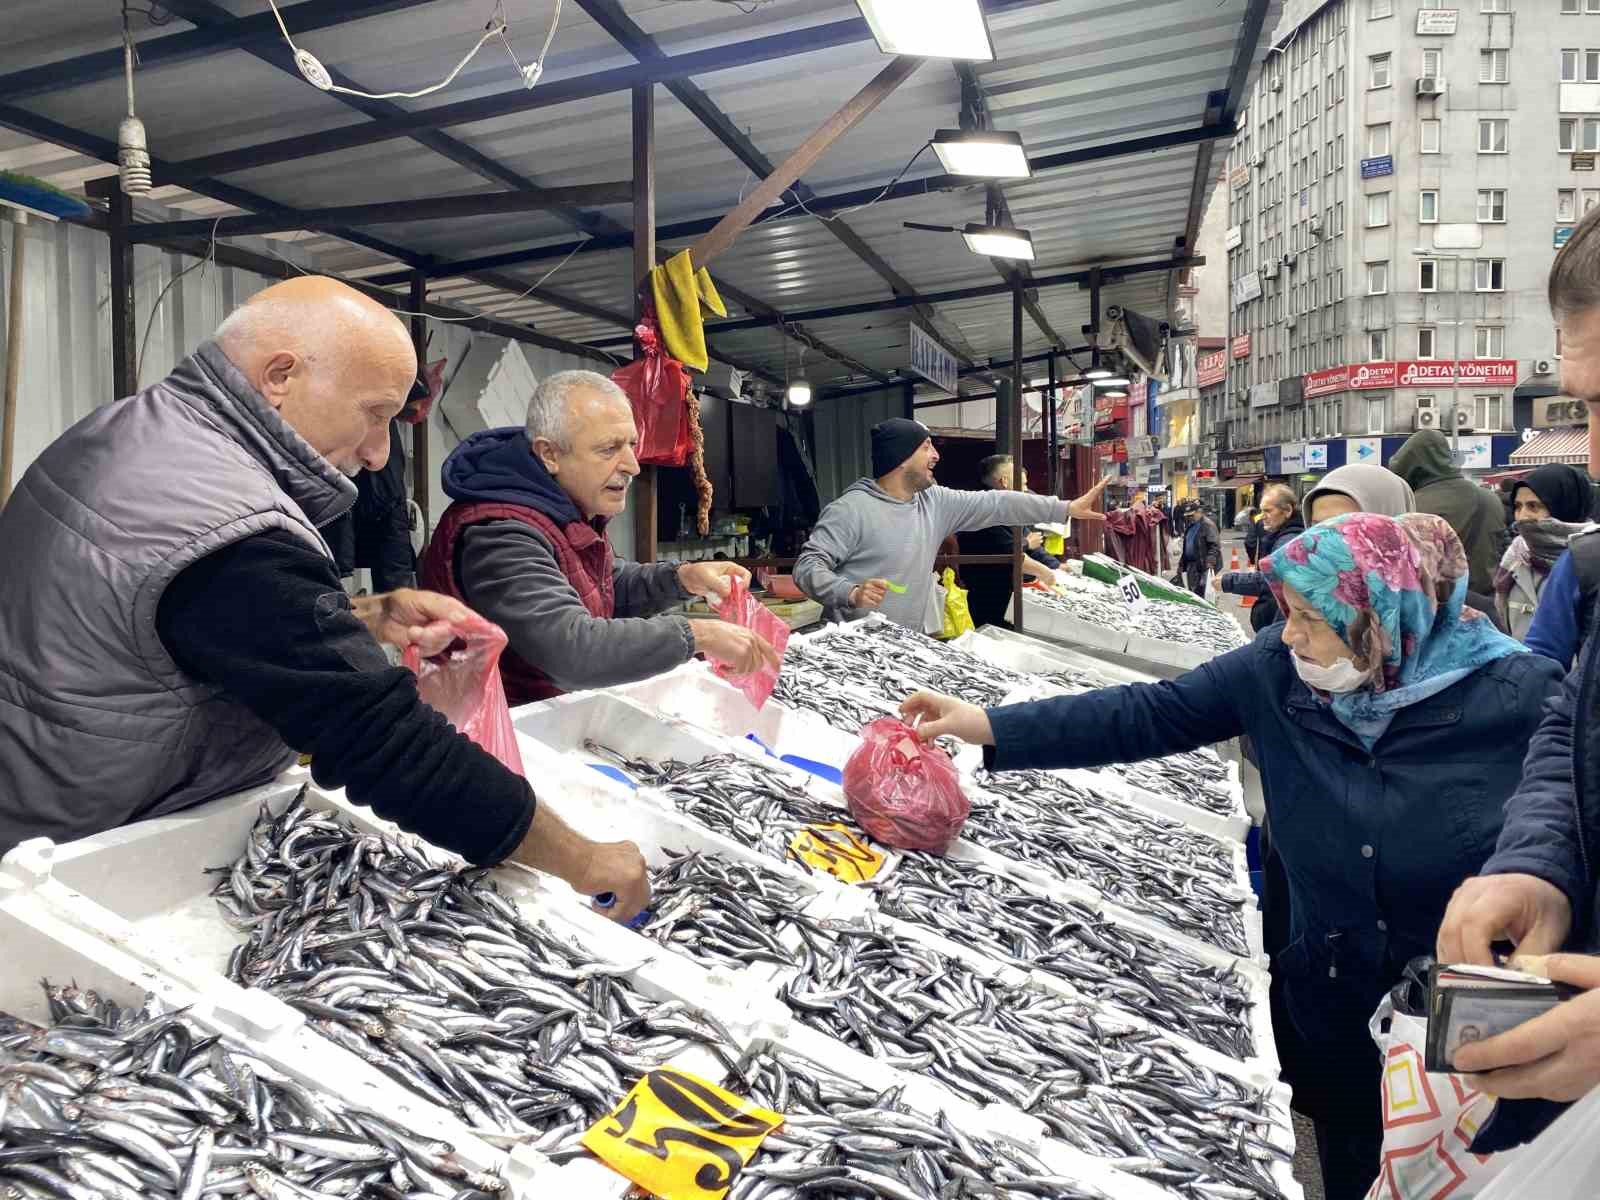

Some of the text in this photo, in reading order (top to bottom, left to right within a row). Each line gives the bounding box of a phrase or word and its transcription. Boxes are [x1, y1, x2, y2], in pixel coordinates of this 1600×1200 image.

[1369, 367, 1394, 376] DETAY
[1420, 363, 1513, 376] DETAY YÖNETİM
[1122, 581, 1141, 604] 50
